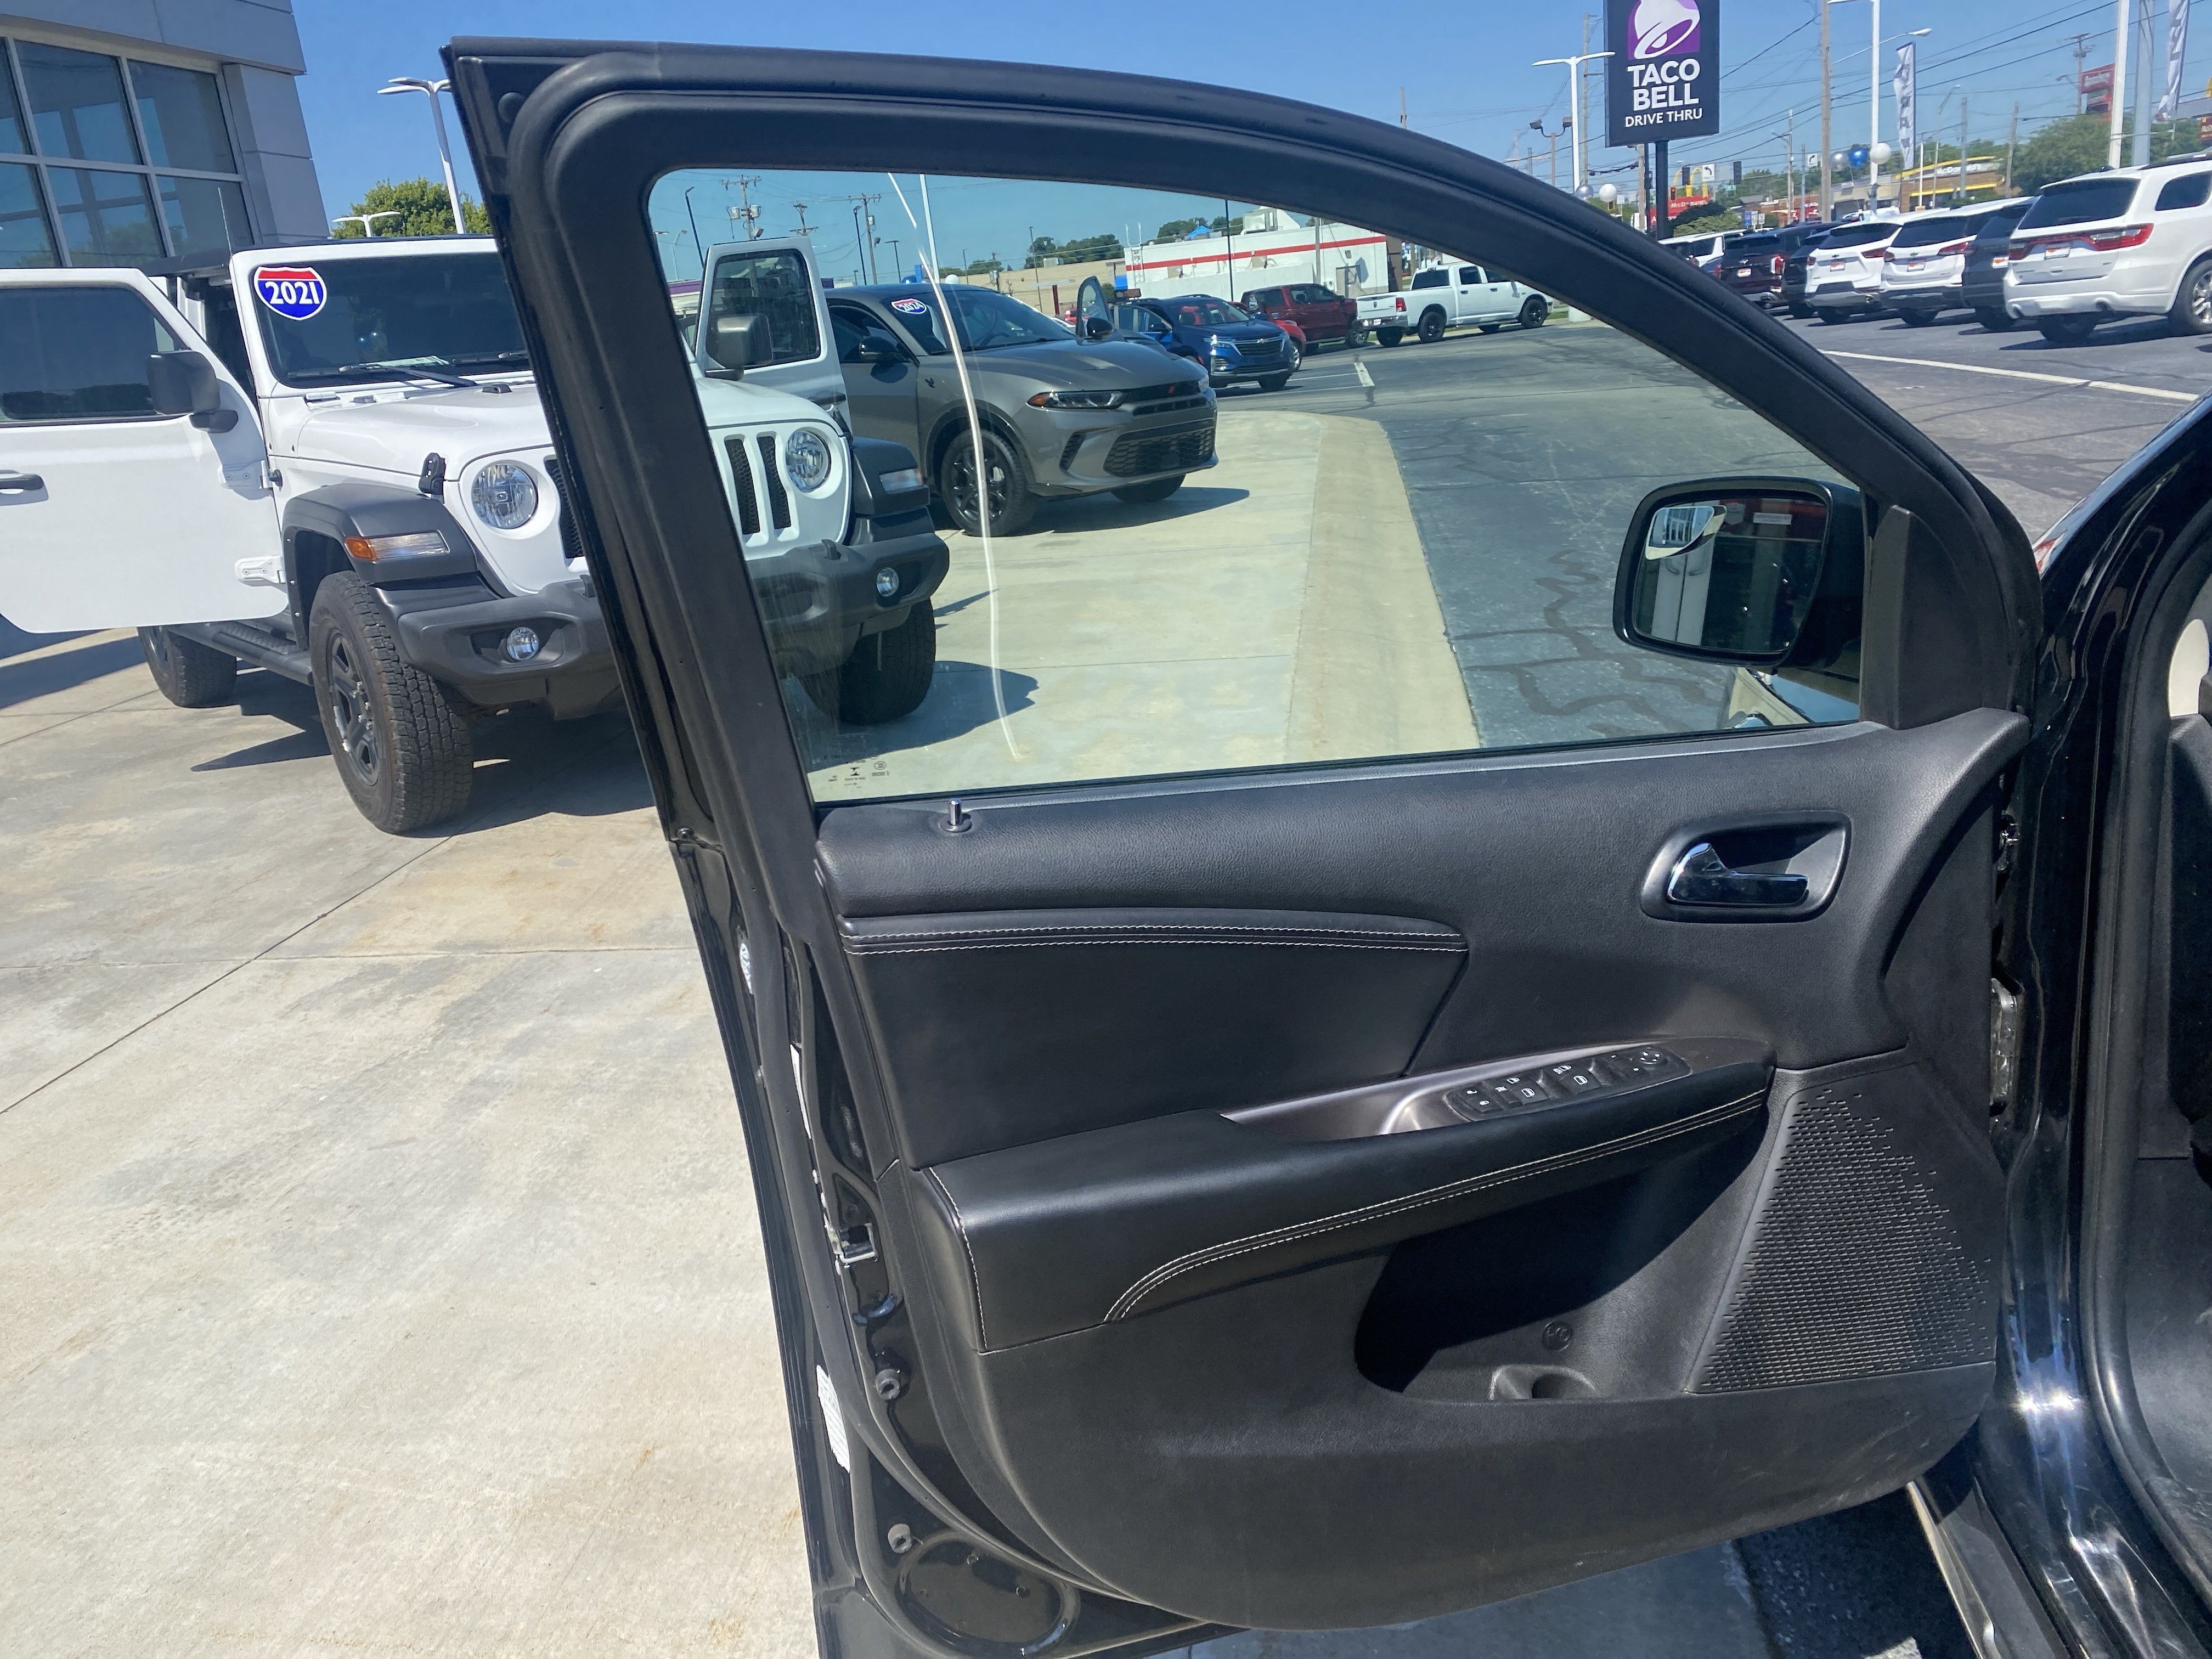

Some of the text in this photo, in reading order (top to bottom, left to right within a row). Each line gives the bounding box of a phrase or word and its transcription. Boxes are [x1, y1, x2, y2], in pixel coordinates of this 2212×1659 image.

[1627, 58, 1700, 87] TACO
[1633, 83, 1699, 111] BELL
[1625, 108, 1703, 127] DRIVE THRU
[264, 281, 320, 304] 2021
[898, 301, 924, 312] 2024
